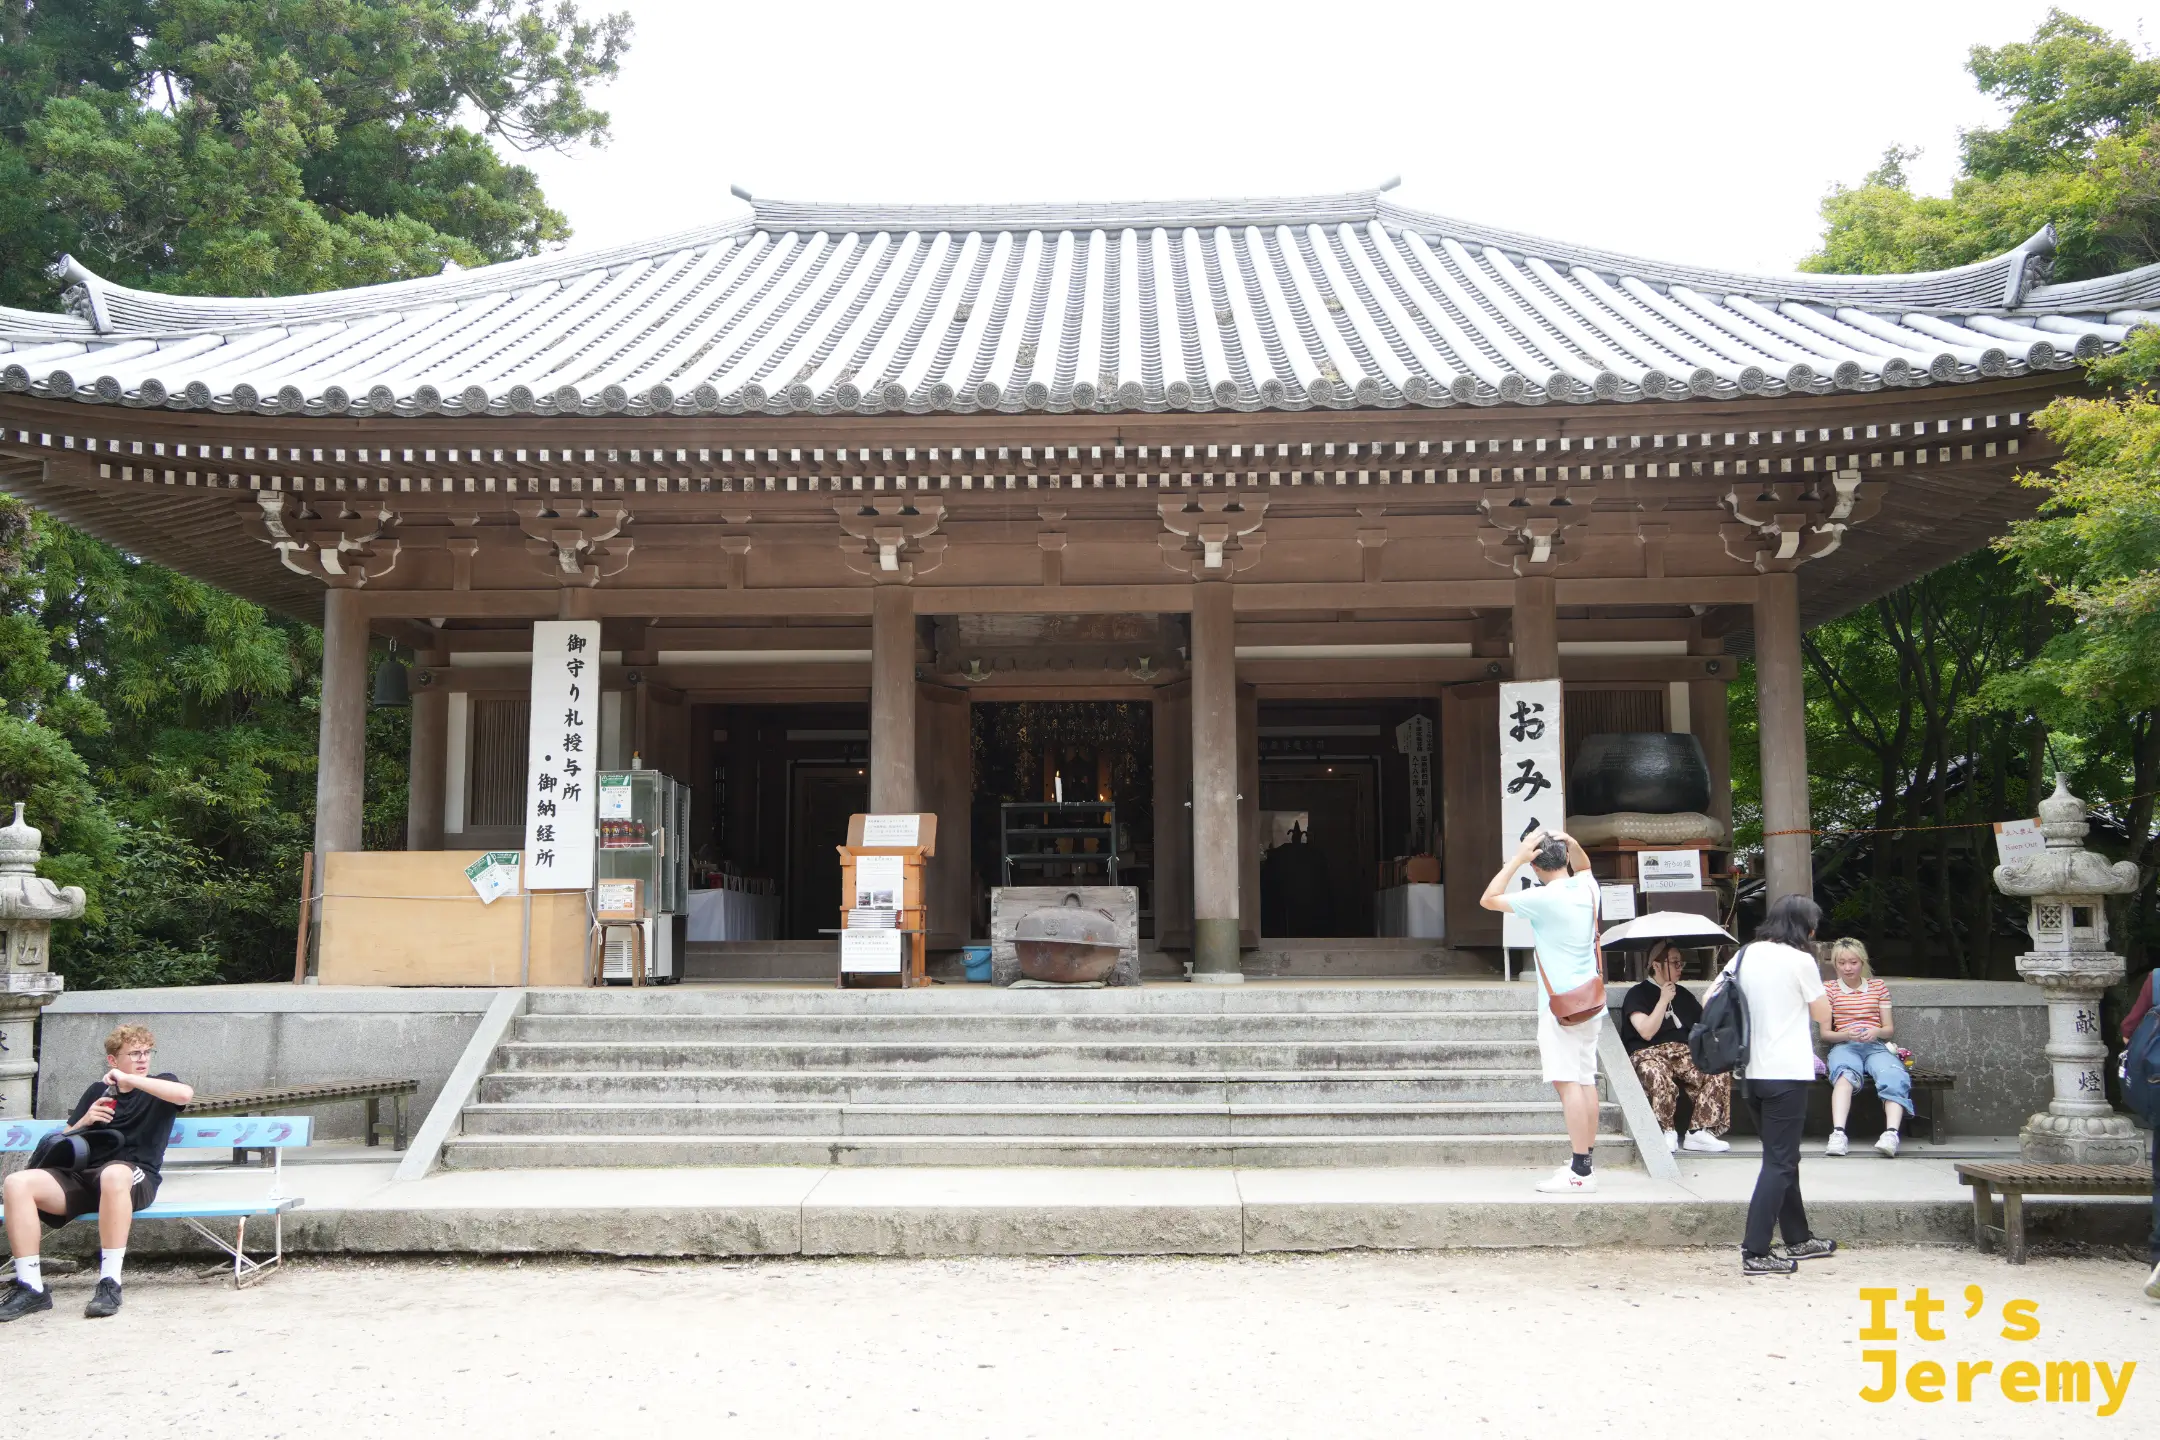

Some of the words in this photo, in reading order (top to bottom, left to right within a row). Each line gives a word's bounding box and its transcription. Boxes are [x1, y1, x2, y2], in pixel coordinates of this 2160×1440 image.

[562, 633, 587, 803] 御守り札授与所
[2004, 843, 2023, 851] Keep
[2024, 841, 2038, 849] Out
[2075, 1009, 2101, 1092] 献燈
